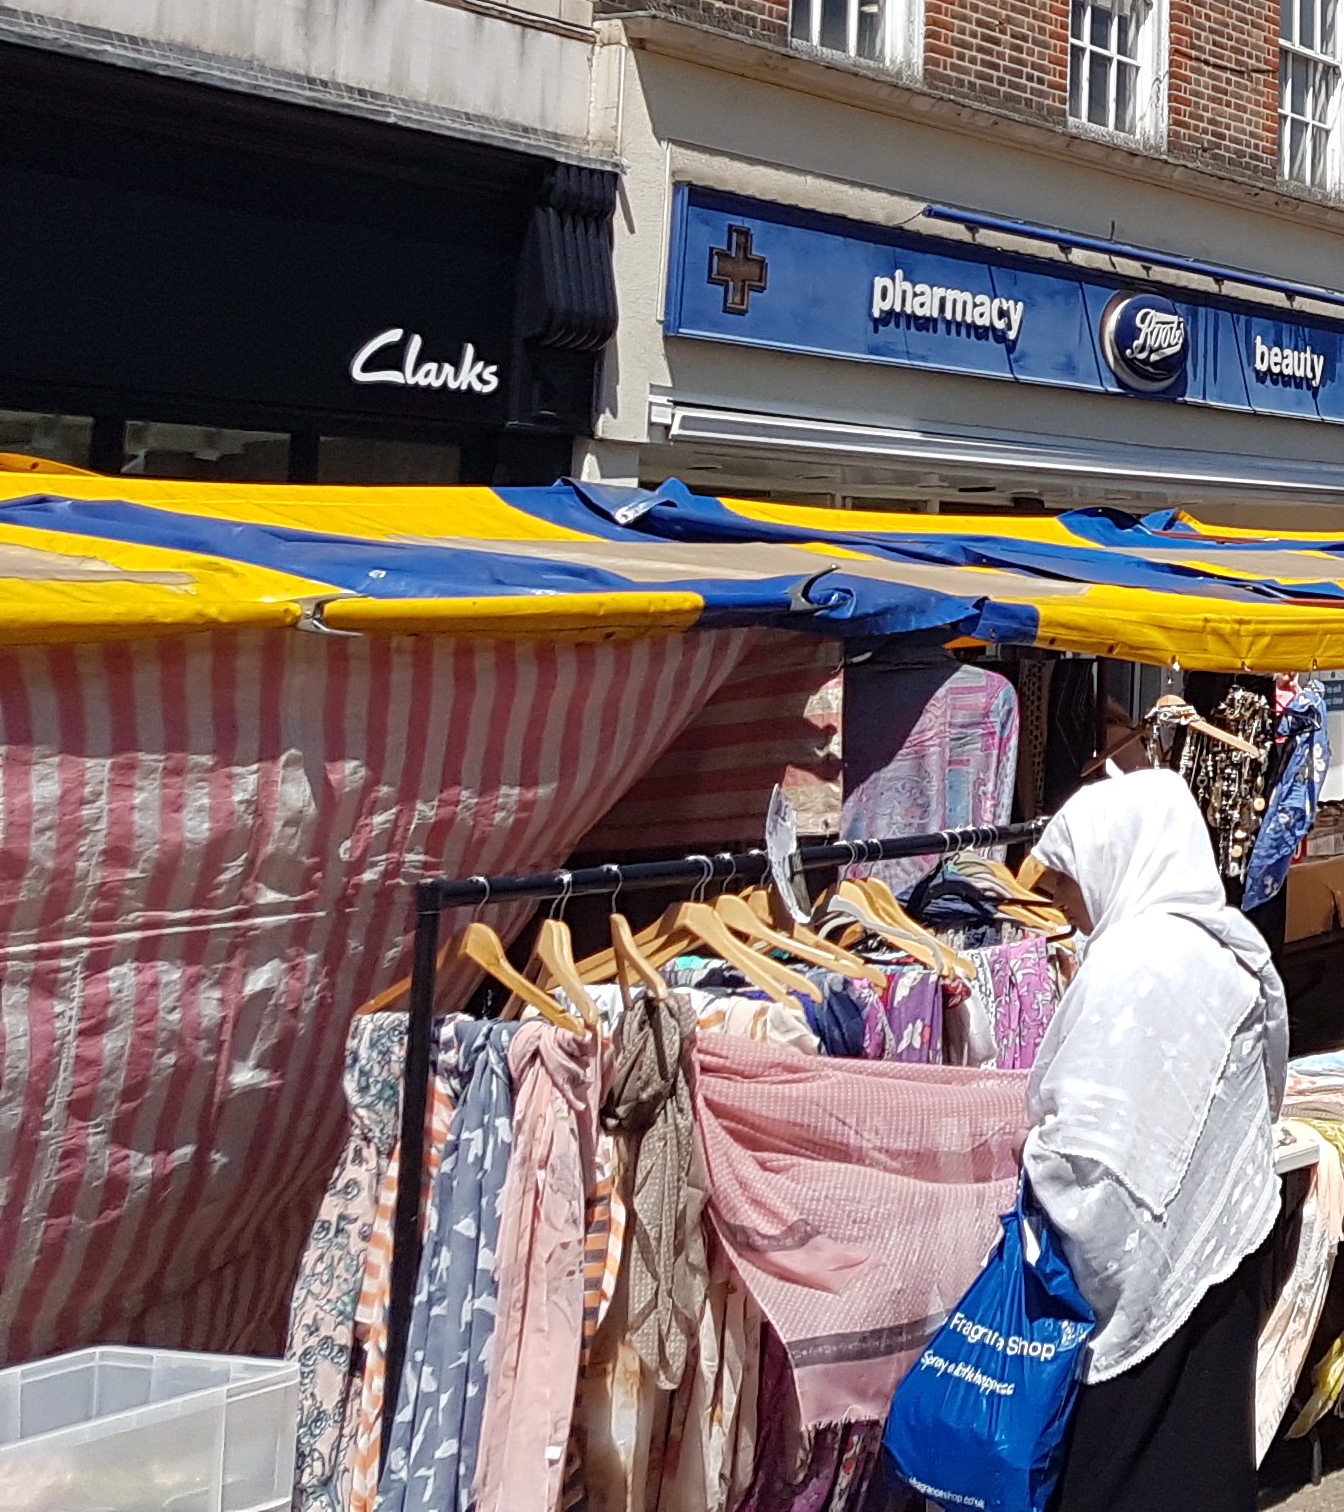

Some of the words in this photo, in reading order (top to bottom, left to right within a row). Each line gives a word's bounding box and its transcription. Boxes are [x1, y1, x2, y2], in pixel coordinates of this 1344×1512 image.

[872, 269, 1024, 341] pharmacy
[350, 328, 499, 393] Clarks
[1126, 308, 1185, 363] Boots
[1253, 335, 1325, 387] beauty
[920, 1350, 950, 1377] Spray
[1006, 1336, 1056, 1361] Shop
